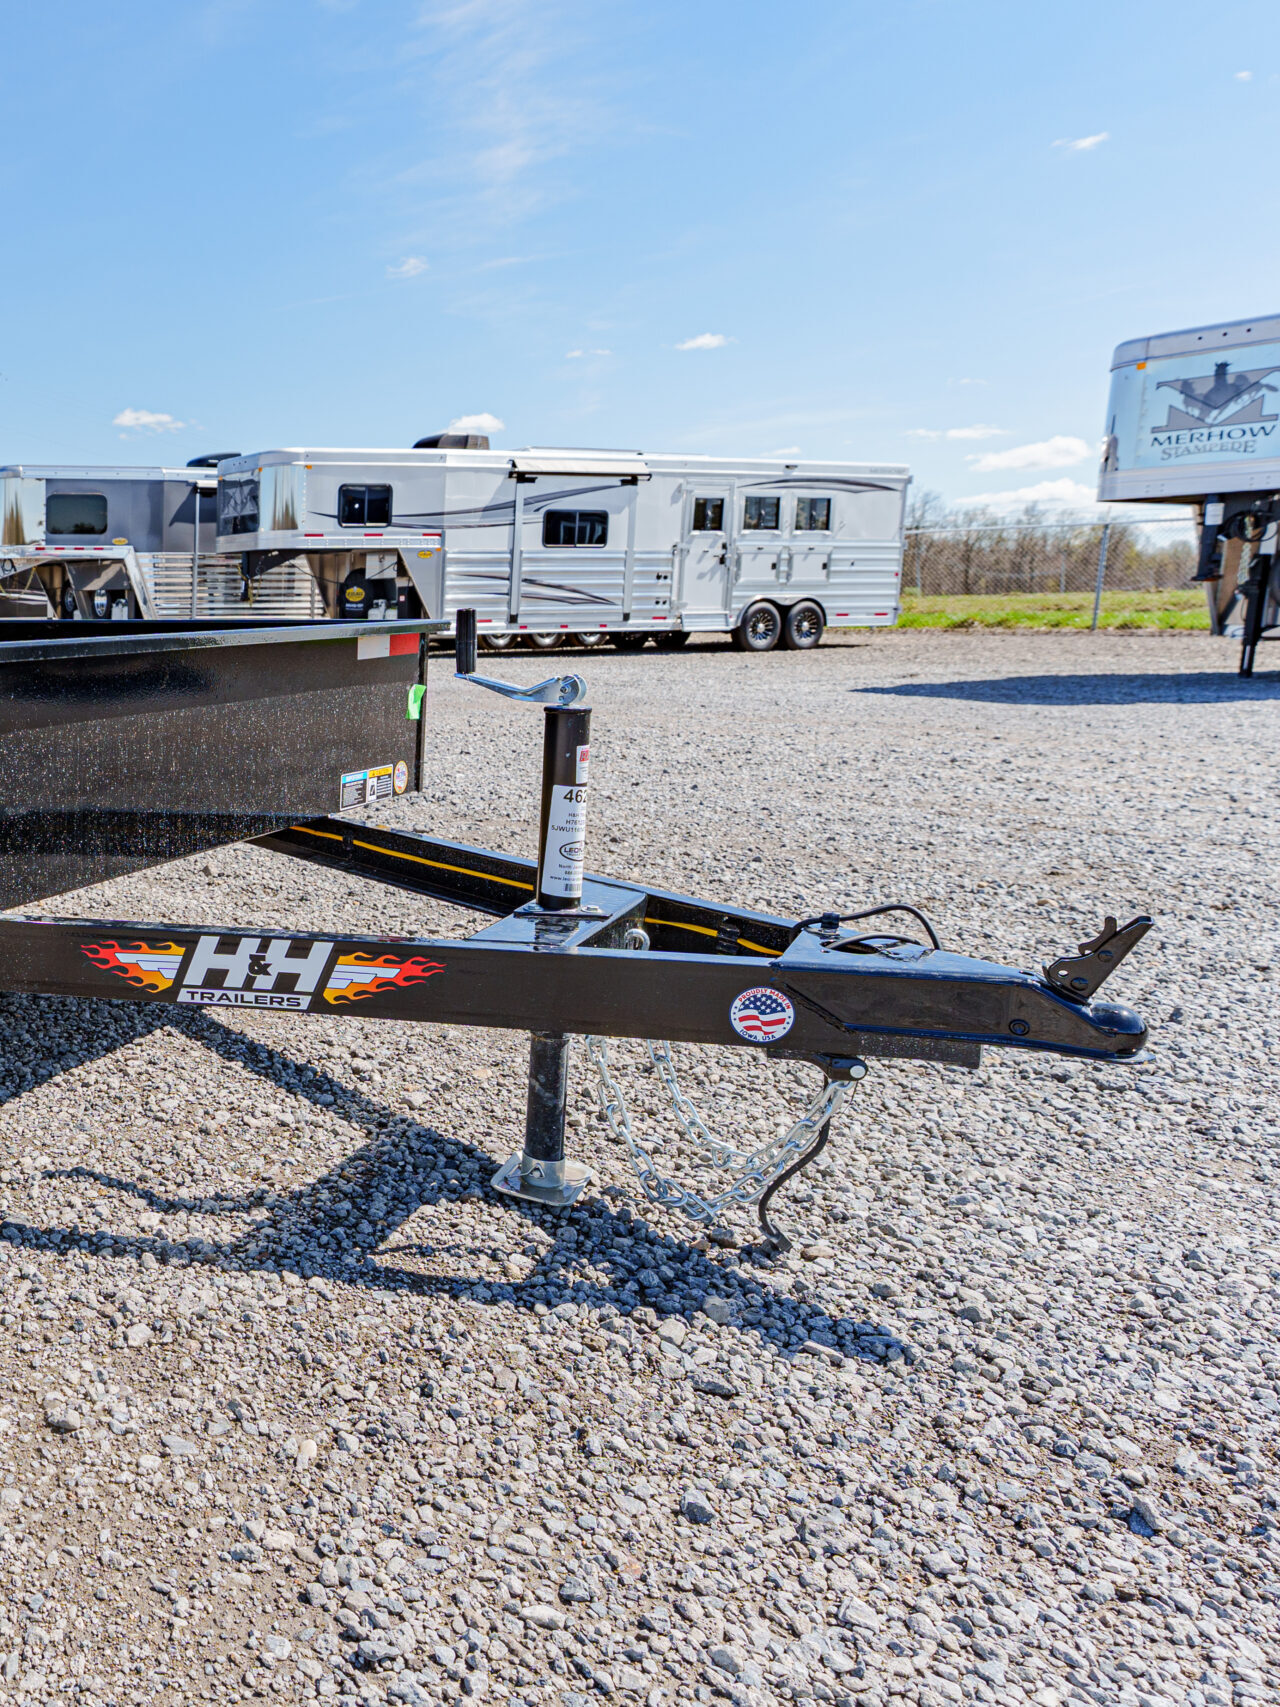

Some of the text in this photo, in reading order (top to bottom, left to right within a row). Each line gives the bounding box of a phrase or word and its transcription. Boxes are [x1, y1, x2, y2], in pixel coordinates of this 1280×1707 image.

[1150, 424, 1276, 447] MERHOW
[182, 935, 335, 993] H&H
[186, 990, 302, 1008] TRAILERS
[738, 988, 792, 1010] PROUDLY MADE IN
